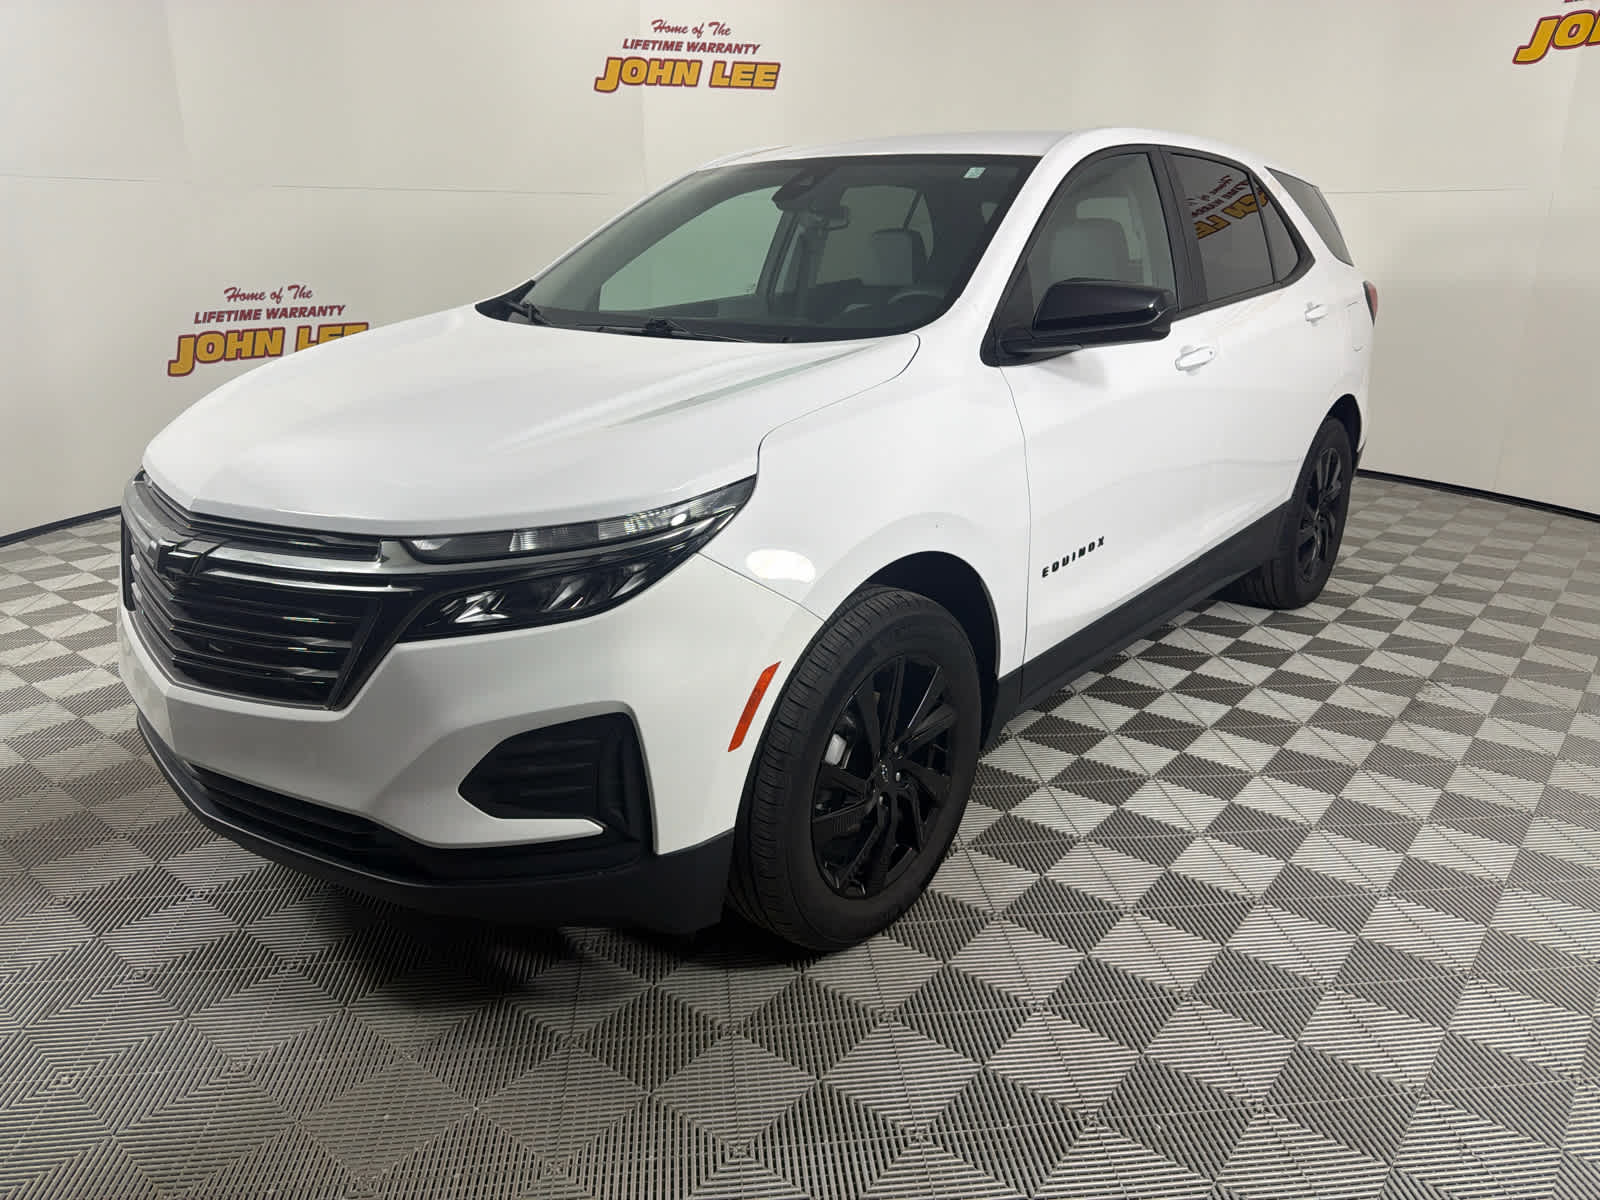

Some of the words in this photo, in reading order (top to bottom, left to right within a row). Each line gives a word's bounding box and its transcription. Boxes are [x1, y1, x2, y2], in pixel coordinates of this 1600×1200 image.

[651, 19, 688, 35] Home
[691, 23, 704, 38] of
[708, 21, 732, 36] The
[622, 38, 684, 53] LIFETIME
[686, 41, 760, 55] WARRANTY
[594, 56, 703, 93] JOHN
[709, 60, 781, 90] LEE
[223, 286, 265, 303] Home
[270, 287, 284, 304] of
[288, 284, 313, 300] The
[194, 308, 262, 324] LIFETIME
[266, 305, 346, 320] WARRANTY
[168, 327, 285, 377] JOHN
[1041, 536, 1105, 578] EQUINOX
